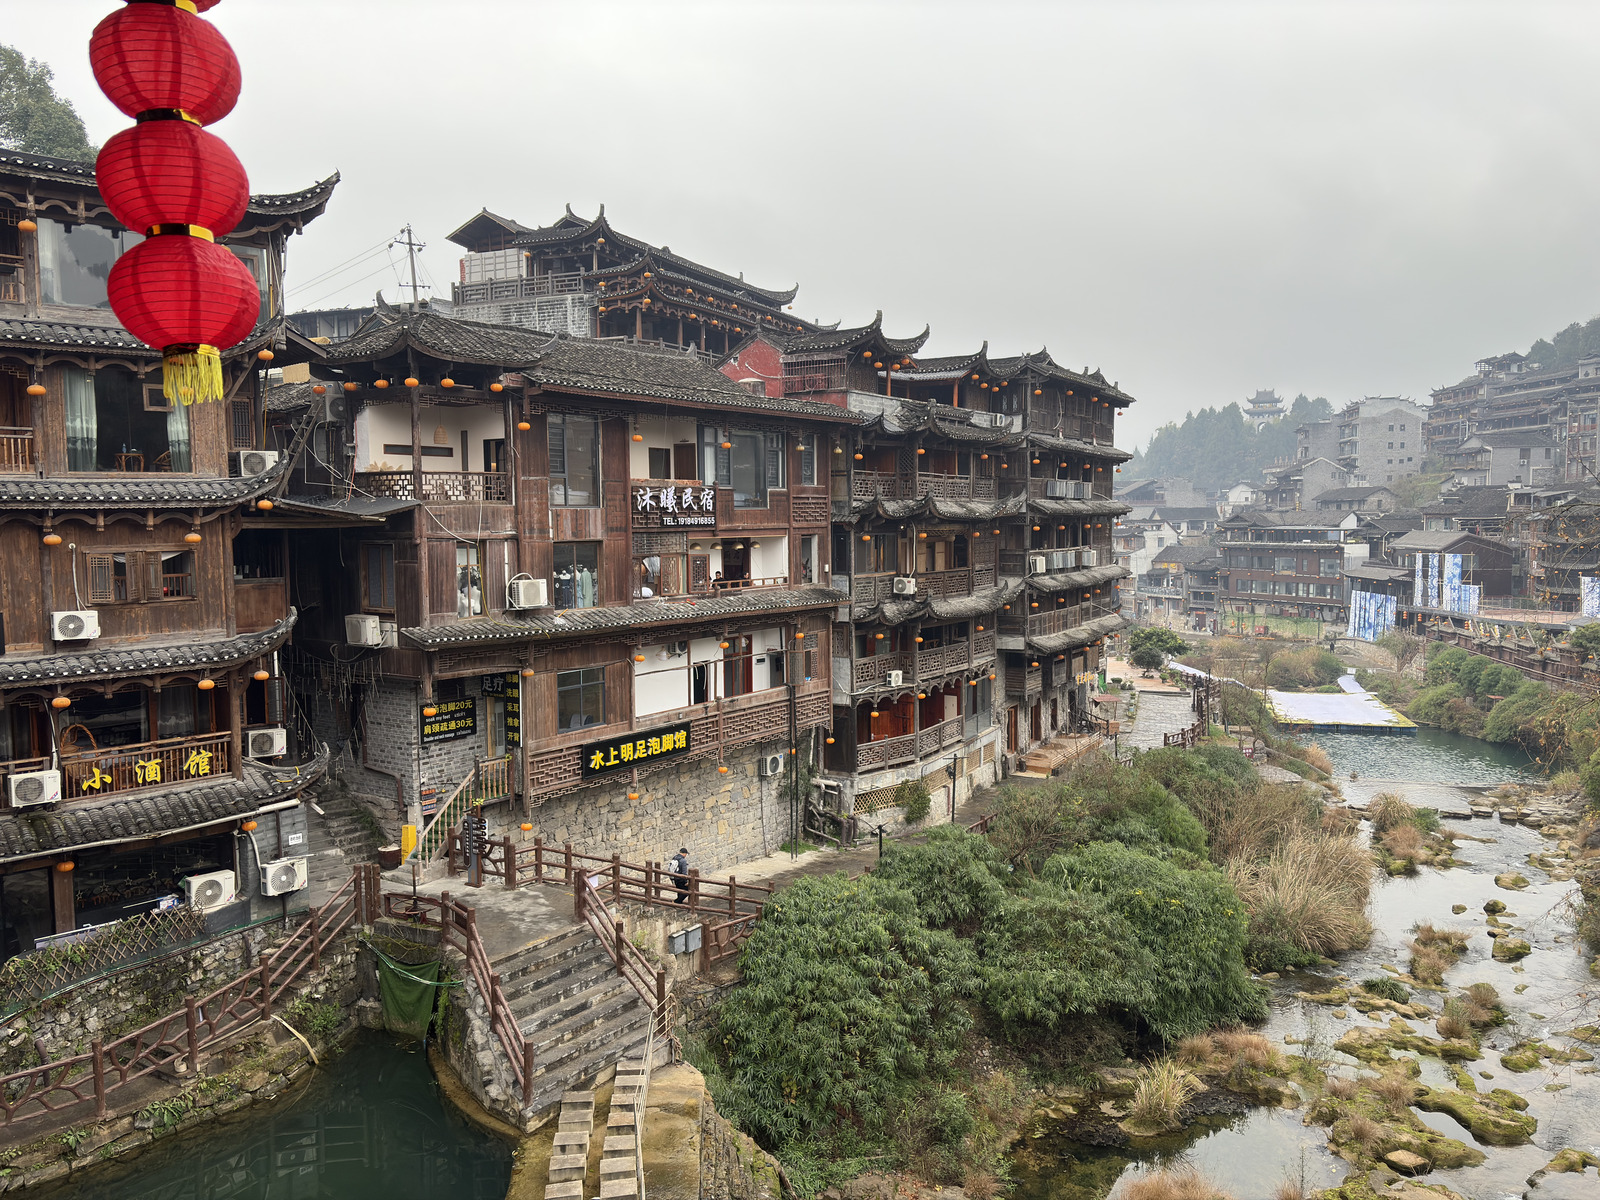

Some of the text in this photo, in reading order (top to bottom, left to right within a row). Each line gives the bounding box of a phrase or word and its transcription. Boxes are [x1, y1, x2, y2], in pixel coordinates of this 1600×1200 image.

[482, 676, 504, 692] 足疗
[424, 699, 473, 714] 泡脚20元
[506, 702, 519, 713] 采耳
[507, 716, 520, 728] 推拿
[589, 729, 687, 770] 水上明足泡脚馆
[81, 749, 213, 791] 小酒馆
